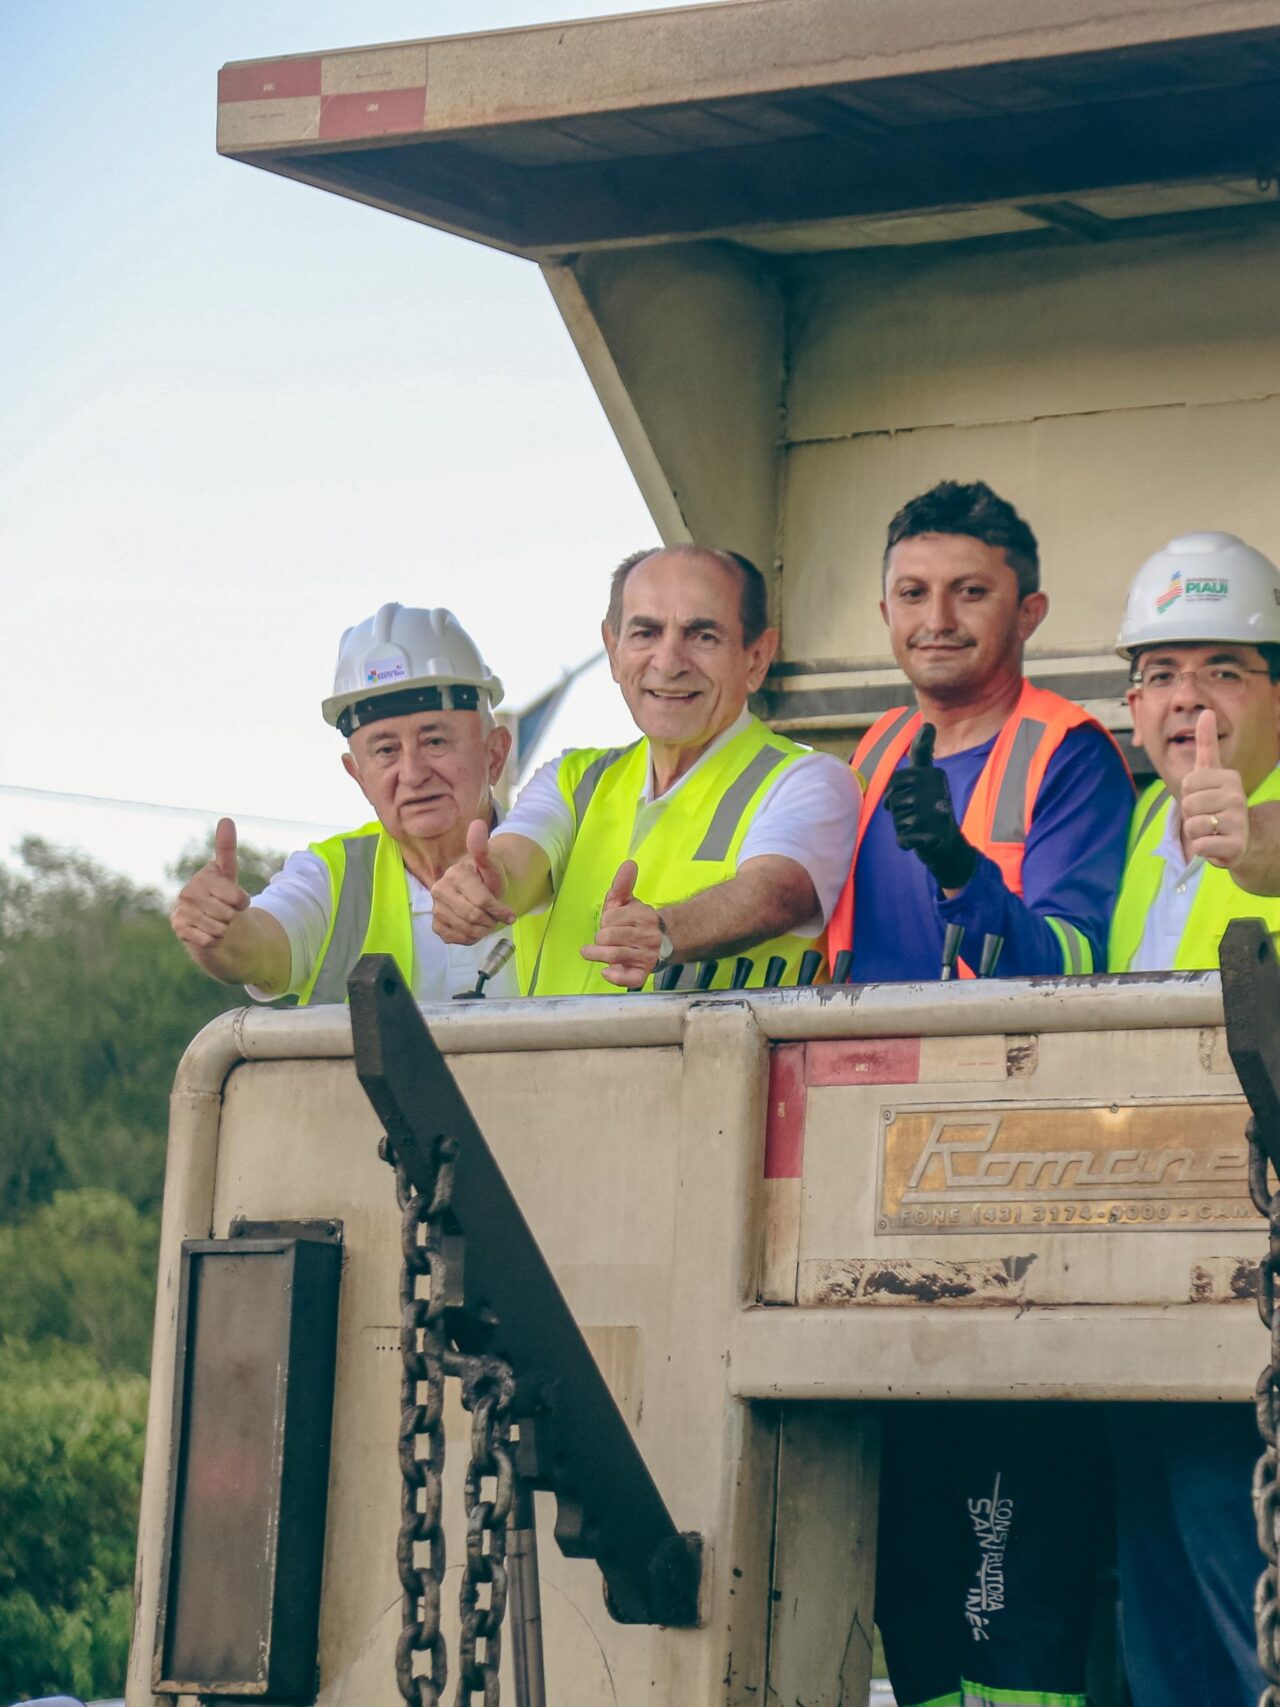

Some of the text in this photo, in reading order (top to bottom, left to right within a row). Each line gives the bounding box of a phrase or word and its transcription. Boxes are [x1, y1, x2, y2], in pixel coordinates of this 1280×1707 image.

[908, 1114, 1250, 1188] Romane
[900, 1208, 961, 1225] FONE
[974, 1206, 1022, 1224] (43)
[1199, 1203, 1250, 1220] CAM
[987, 1499, 1013, 1612] CONSTRUTORA
